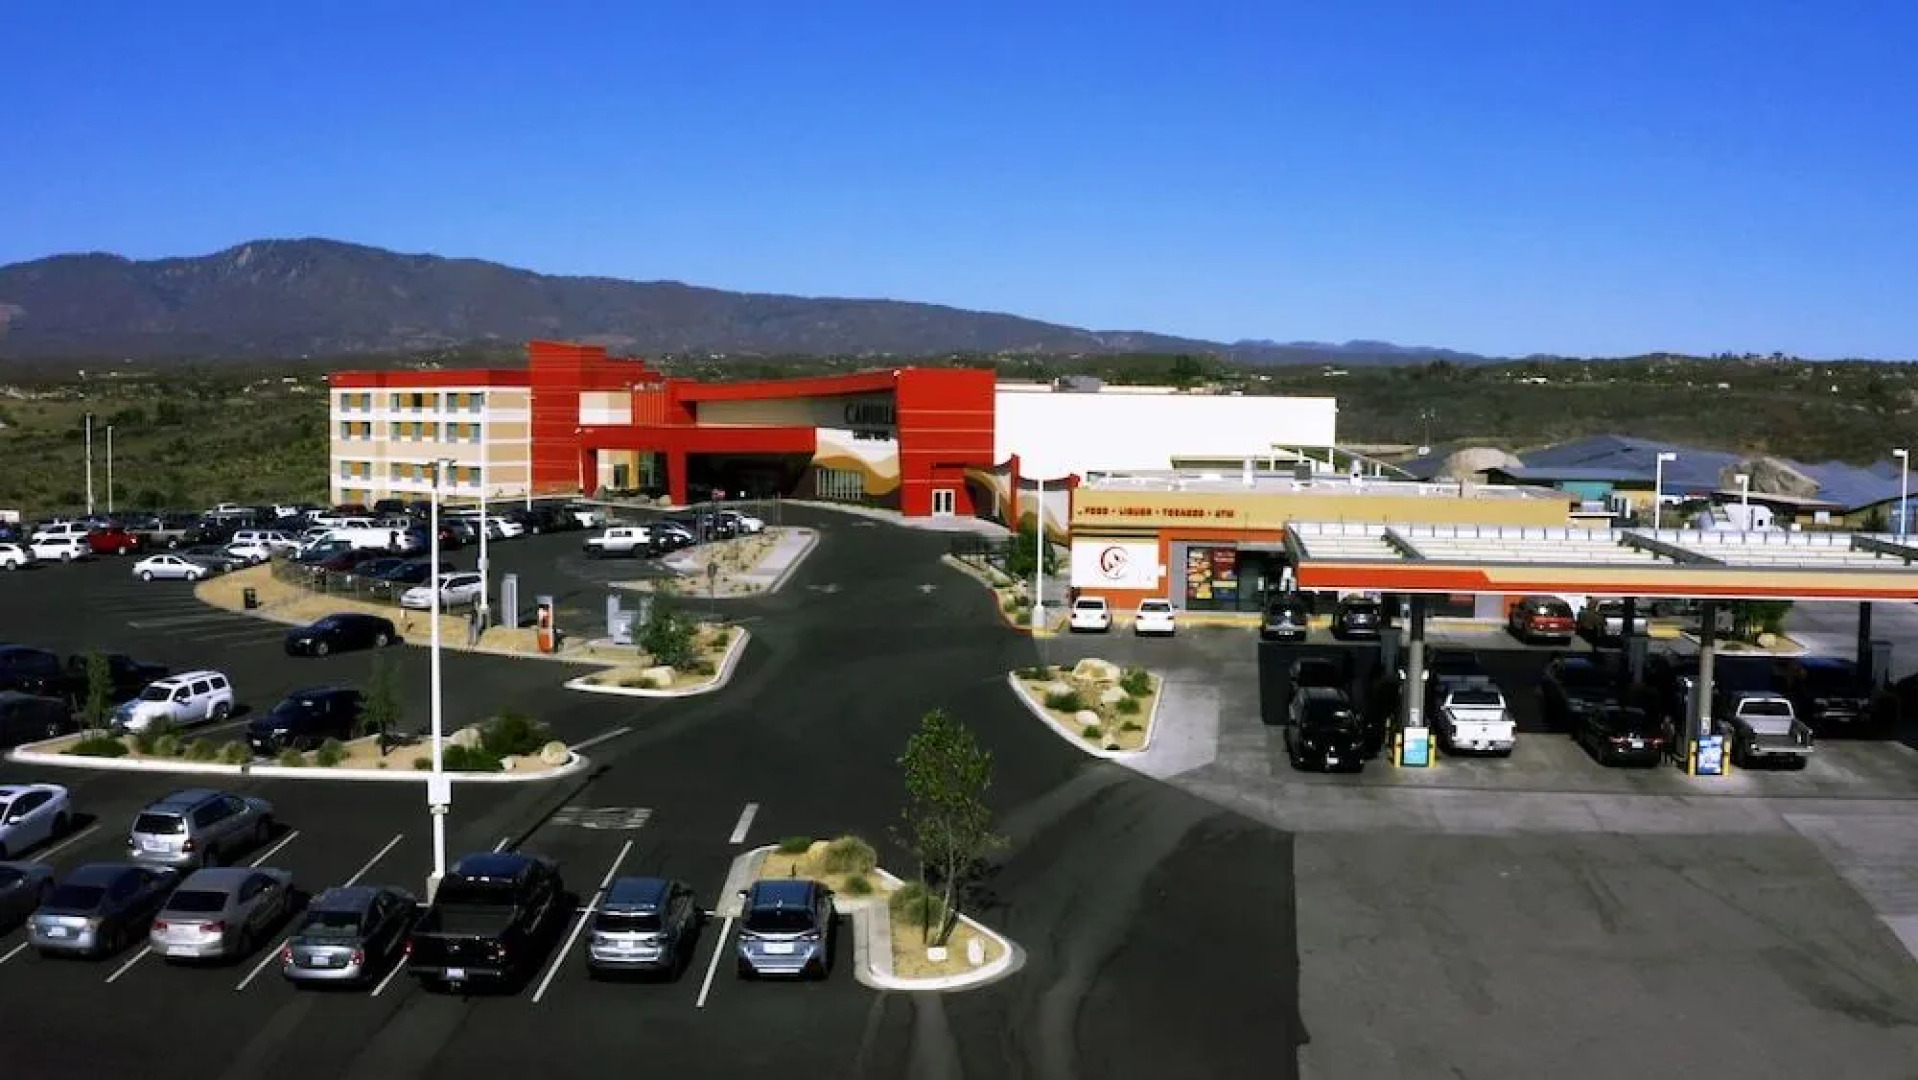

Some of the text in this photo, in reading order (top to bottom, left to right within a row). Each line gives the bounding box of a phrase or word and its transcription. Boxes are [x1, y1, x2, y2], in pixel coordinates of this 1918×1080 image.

[1085, 506, 1109, 516] FOOD
[1119, 506, 1153, 517] LIQUOR
[1162, 507, 1204, 518] TOBACCO
